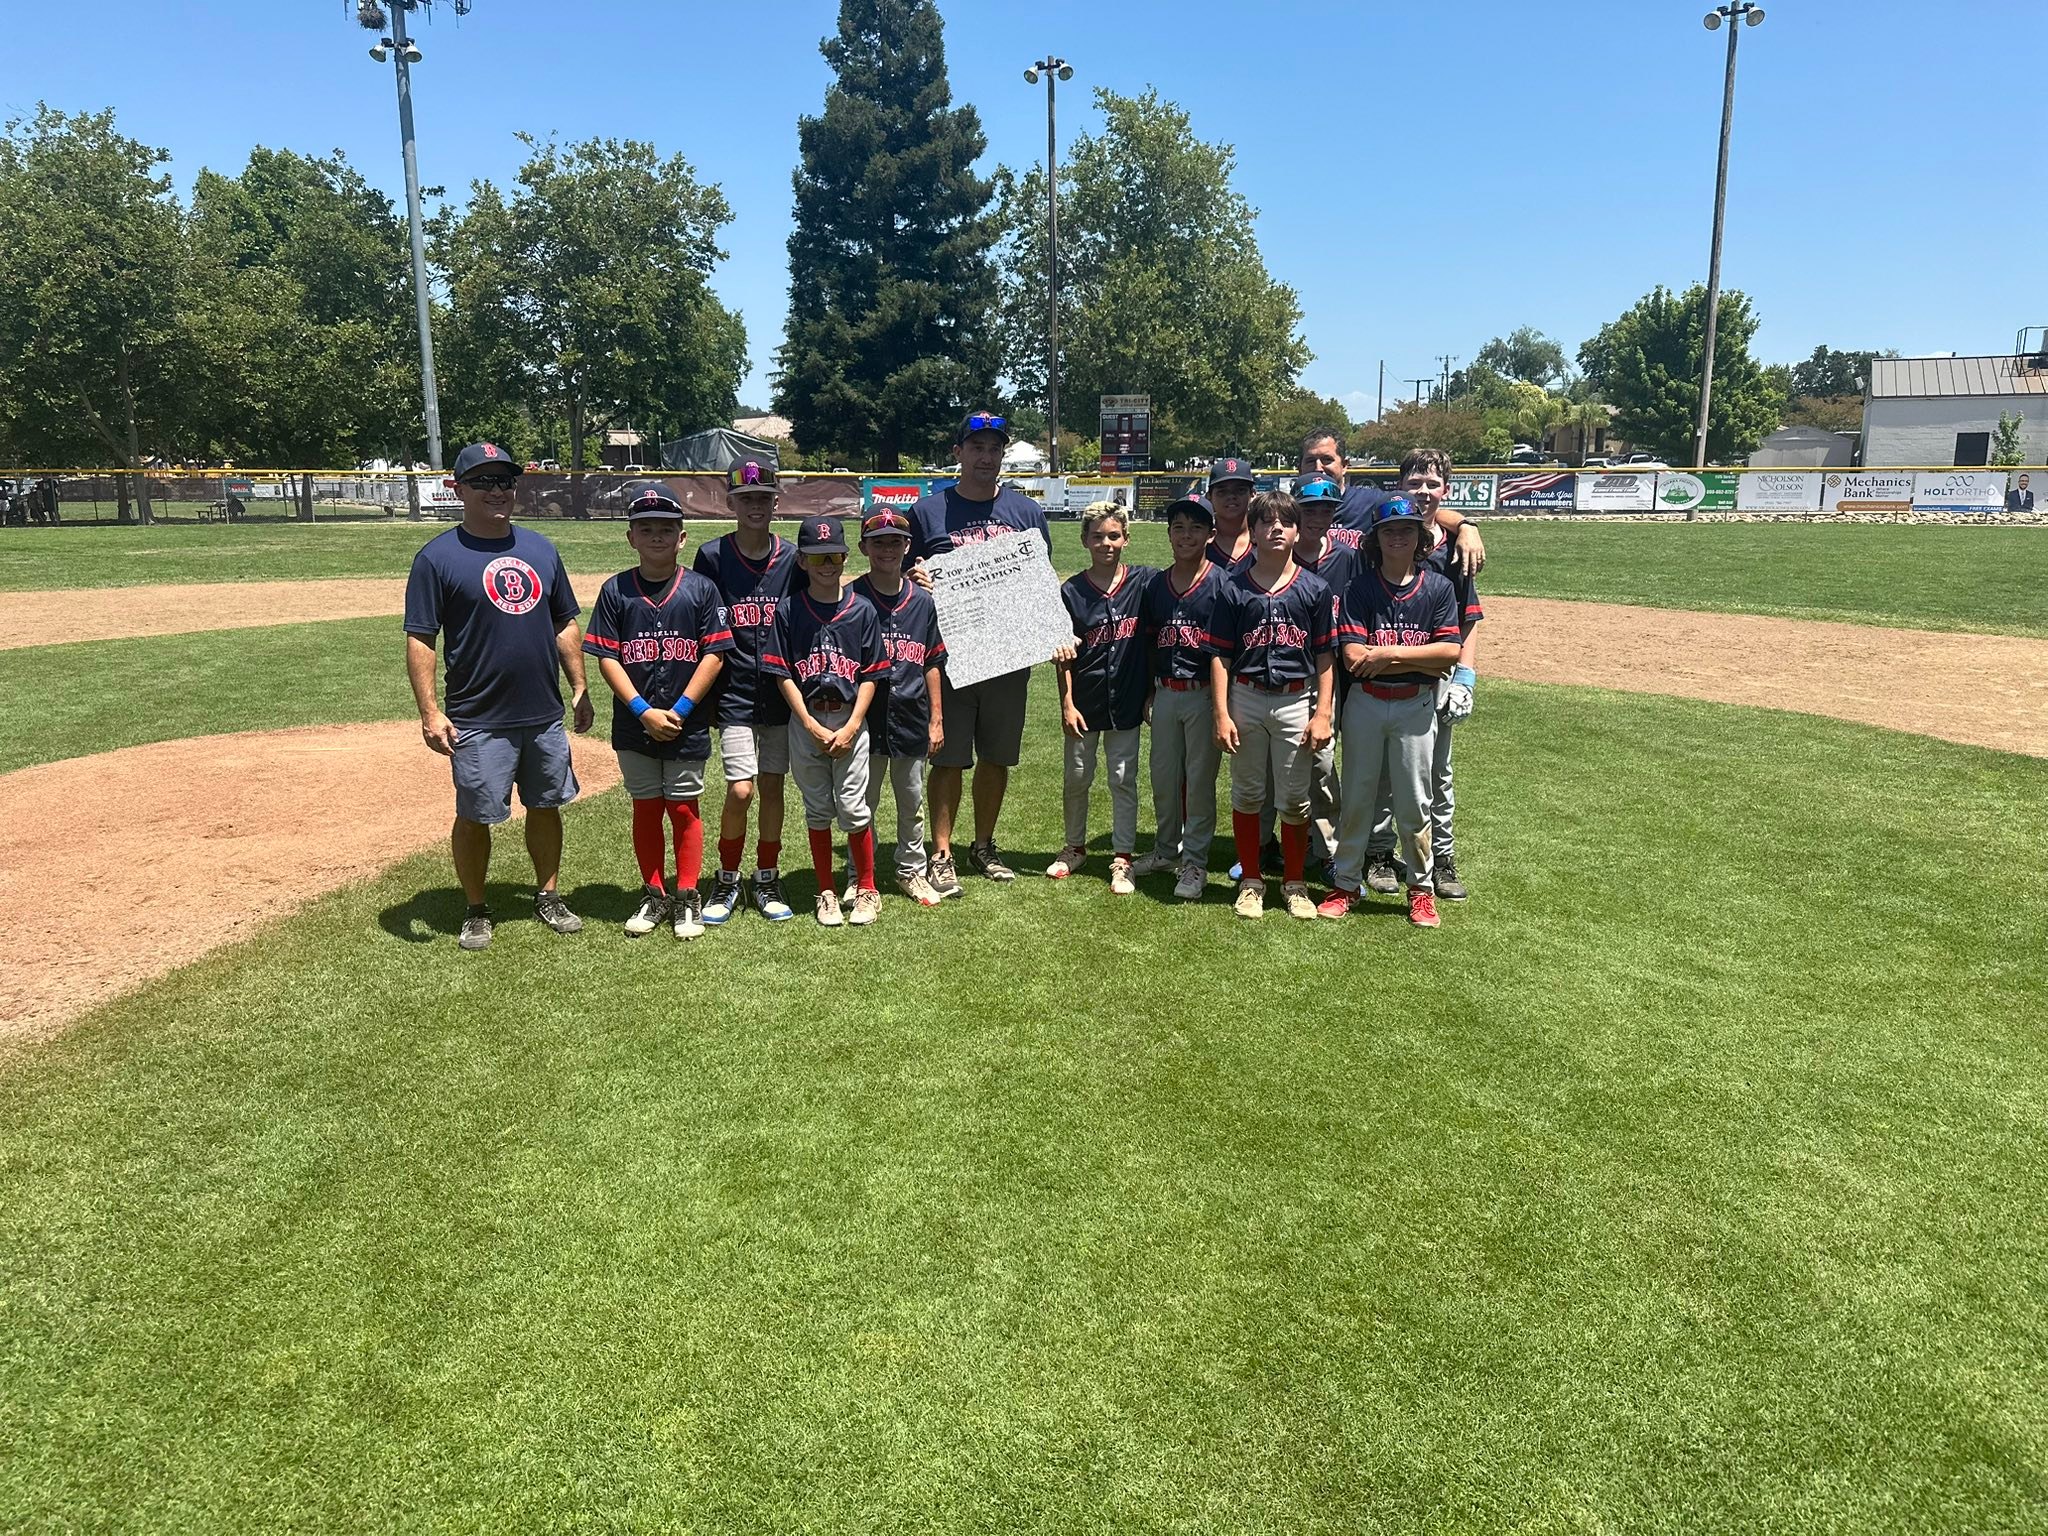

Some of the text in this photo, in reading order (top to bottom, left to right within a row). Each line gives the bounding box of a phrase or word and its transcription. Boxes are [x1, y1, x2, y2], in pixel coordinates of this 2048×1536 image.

[1757, 475, 1805, 483] NICHOLSON
[1775, 483, 1804, 491] OLSON
[1844, 476, 1911, 487] Mechanics
[1447, 481, 1490, 501] CK'S
[1530, 490, 1573, 499] Thank You
[1843, 487, 1873, 498] Bank
[1923, 488, 1996, 496] HOLT ORTHO
[488, 559, 531, 573] ROCKLIN
[946, 568, 963, 578] TOP
[993, 551, 1018, 564] ROCK
[500, 569, 525, 600] B
[951, 566, 1022, 591] CHAMPION
[496, 597, 536, 612] RED SOX
[1276, 623, 1307, 649] SOX
[621, 638, 699, 664] RED SOX
[896, 640, 926, 666] SOX
[829, 652, 861, 684] SOX
